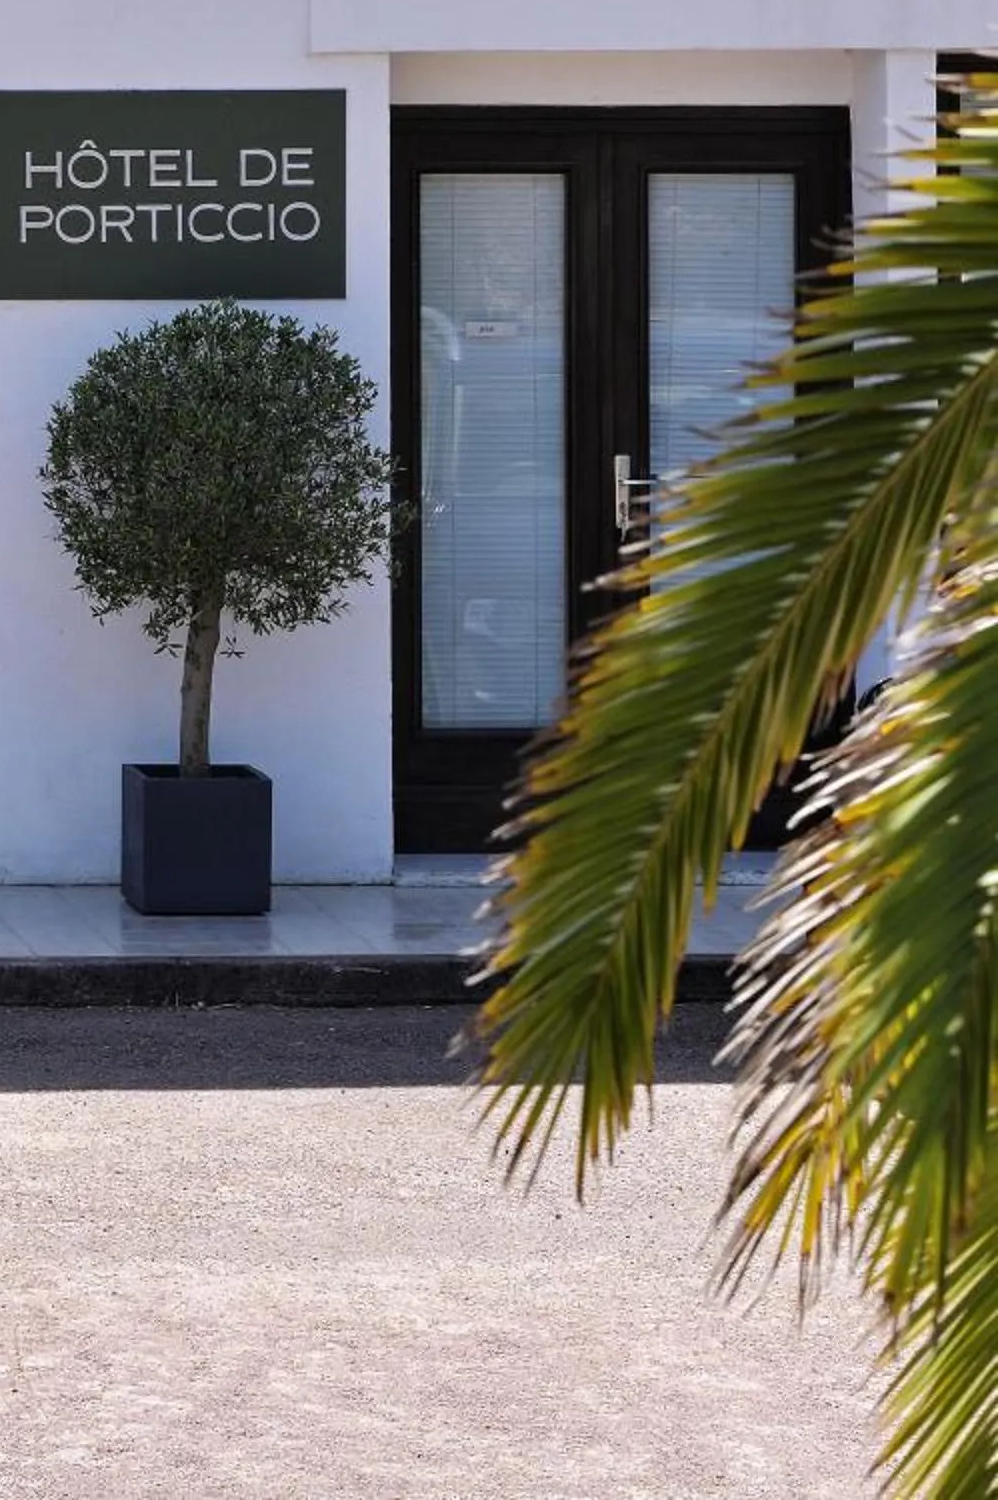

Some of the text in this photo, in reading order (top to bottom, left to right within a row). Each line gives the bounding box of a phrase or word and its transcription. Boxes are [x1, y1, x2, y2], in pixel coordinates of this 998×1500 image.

[24, 139, 316, 189] HÔTEL DE
[19, 201, 321, 244] PORTICCIO
